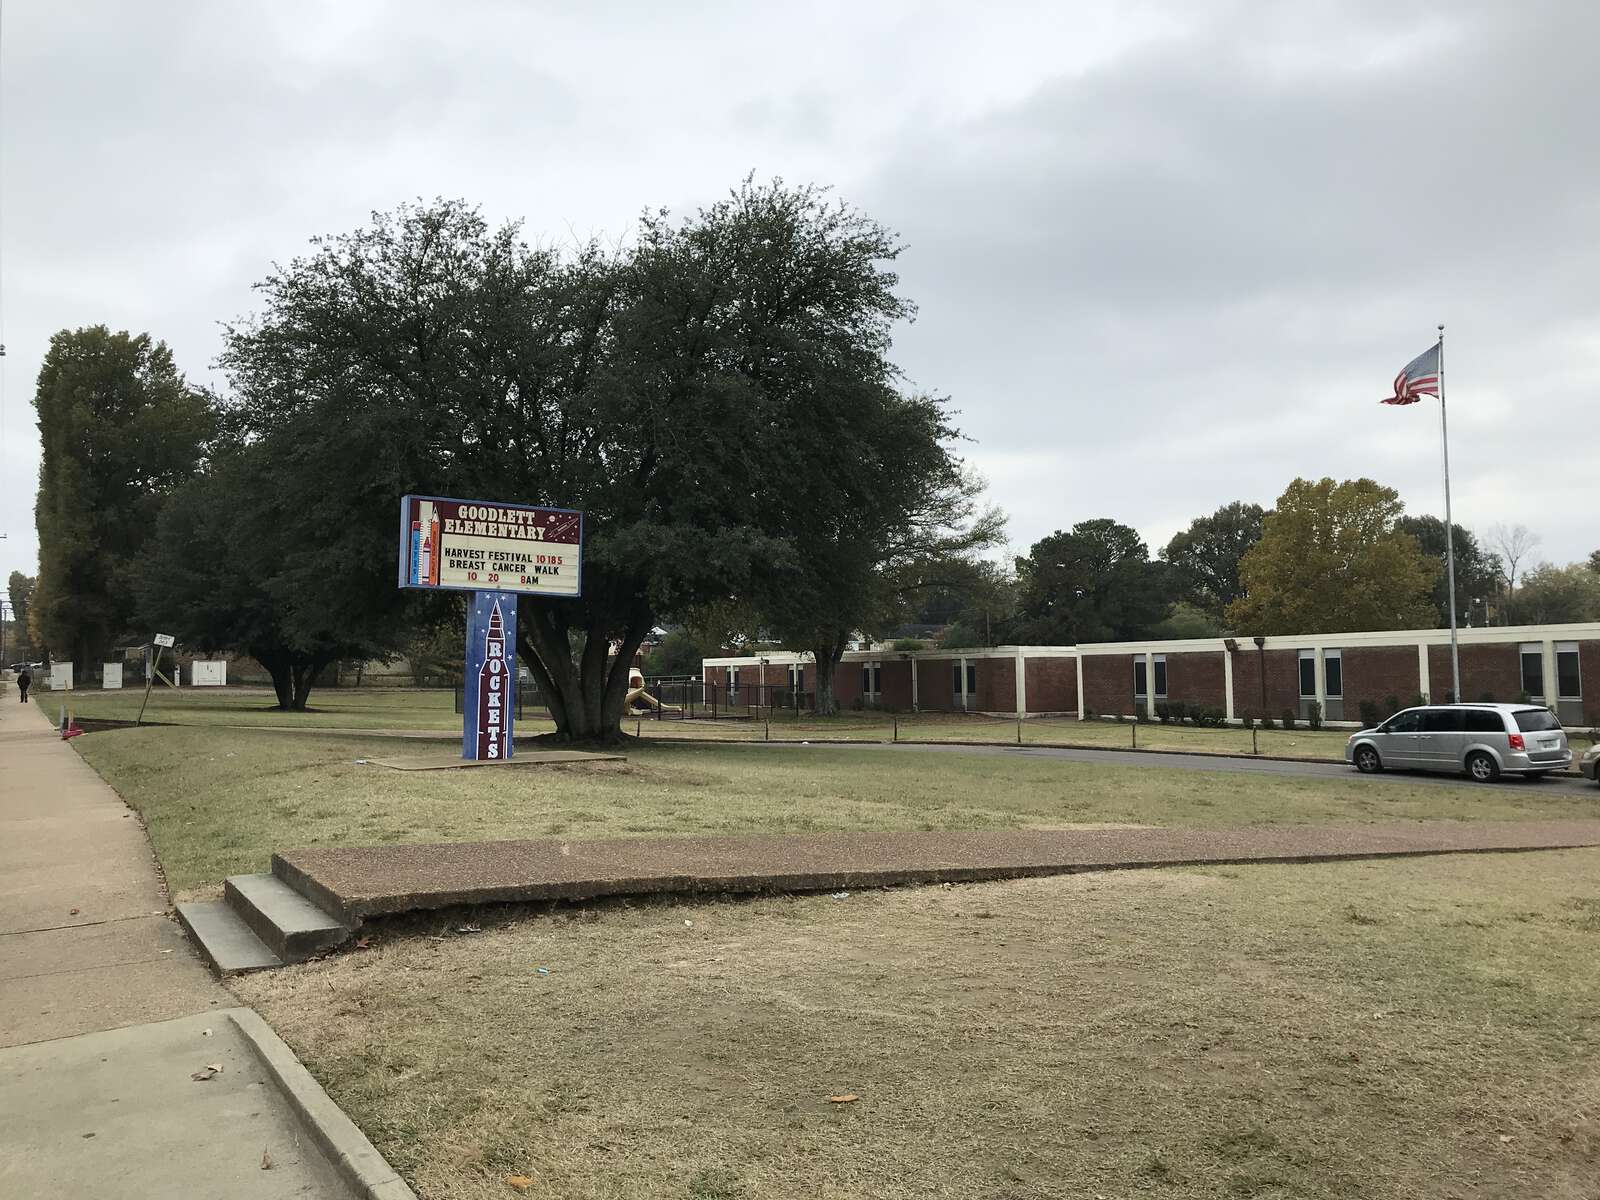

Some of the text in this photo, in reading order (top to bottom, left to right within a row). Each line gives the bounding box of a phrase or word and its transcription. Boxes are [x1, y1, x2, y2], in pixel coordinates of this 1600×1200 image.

[458, 505, 535, 525] GOODLETT
[444, 518, 546, 541] ELEMENTARY
[444, 547, 485, 559] HARVEST
[488, 551, 533, 563] FESTIVAL
[449, 559, 559, 576] BREAST CANCER WALK
[467, 571, 539, 585] 10 20 8AM
[487, 641, 502, 759] ROCKETS
